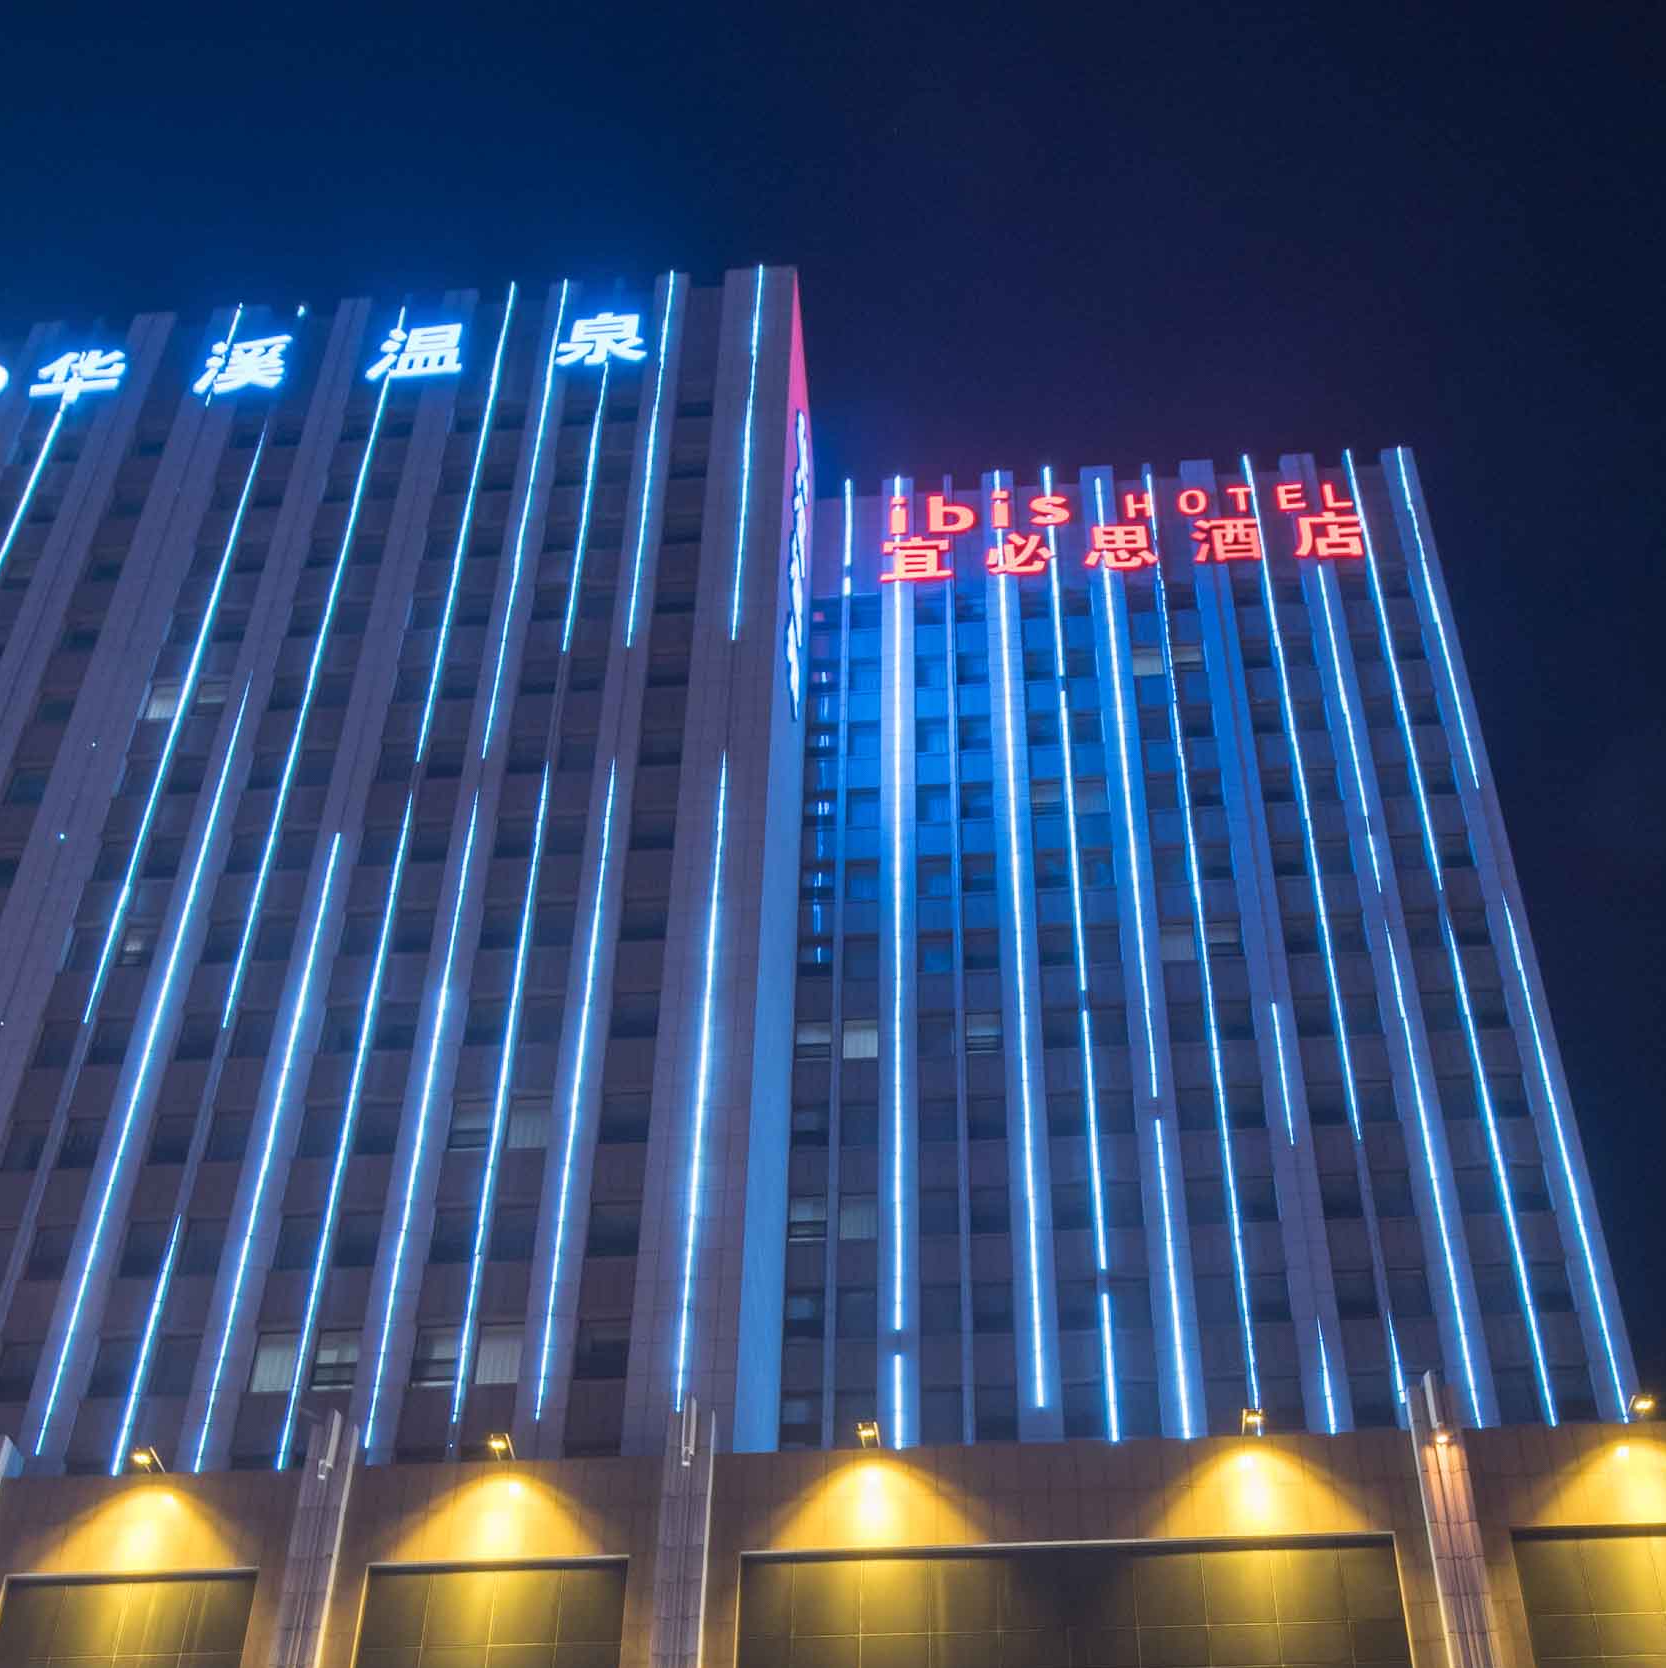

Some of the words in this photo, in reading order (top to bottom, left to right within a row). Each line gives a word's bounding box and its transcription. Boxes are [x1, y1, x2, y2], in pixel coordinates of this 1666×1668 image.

[29, 312, 647, 404] 华溪温泉
[889, 489, 1071, 535] ibis
[1125, 482, 1353, 519] HOTEL
[879, 511, 1365, 583] 宜必思酒店
